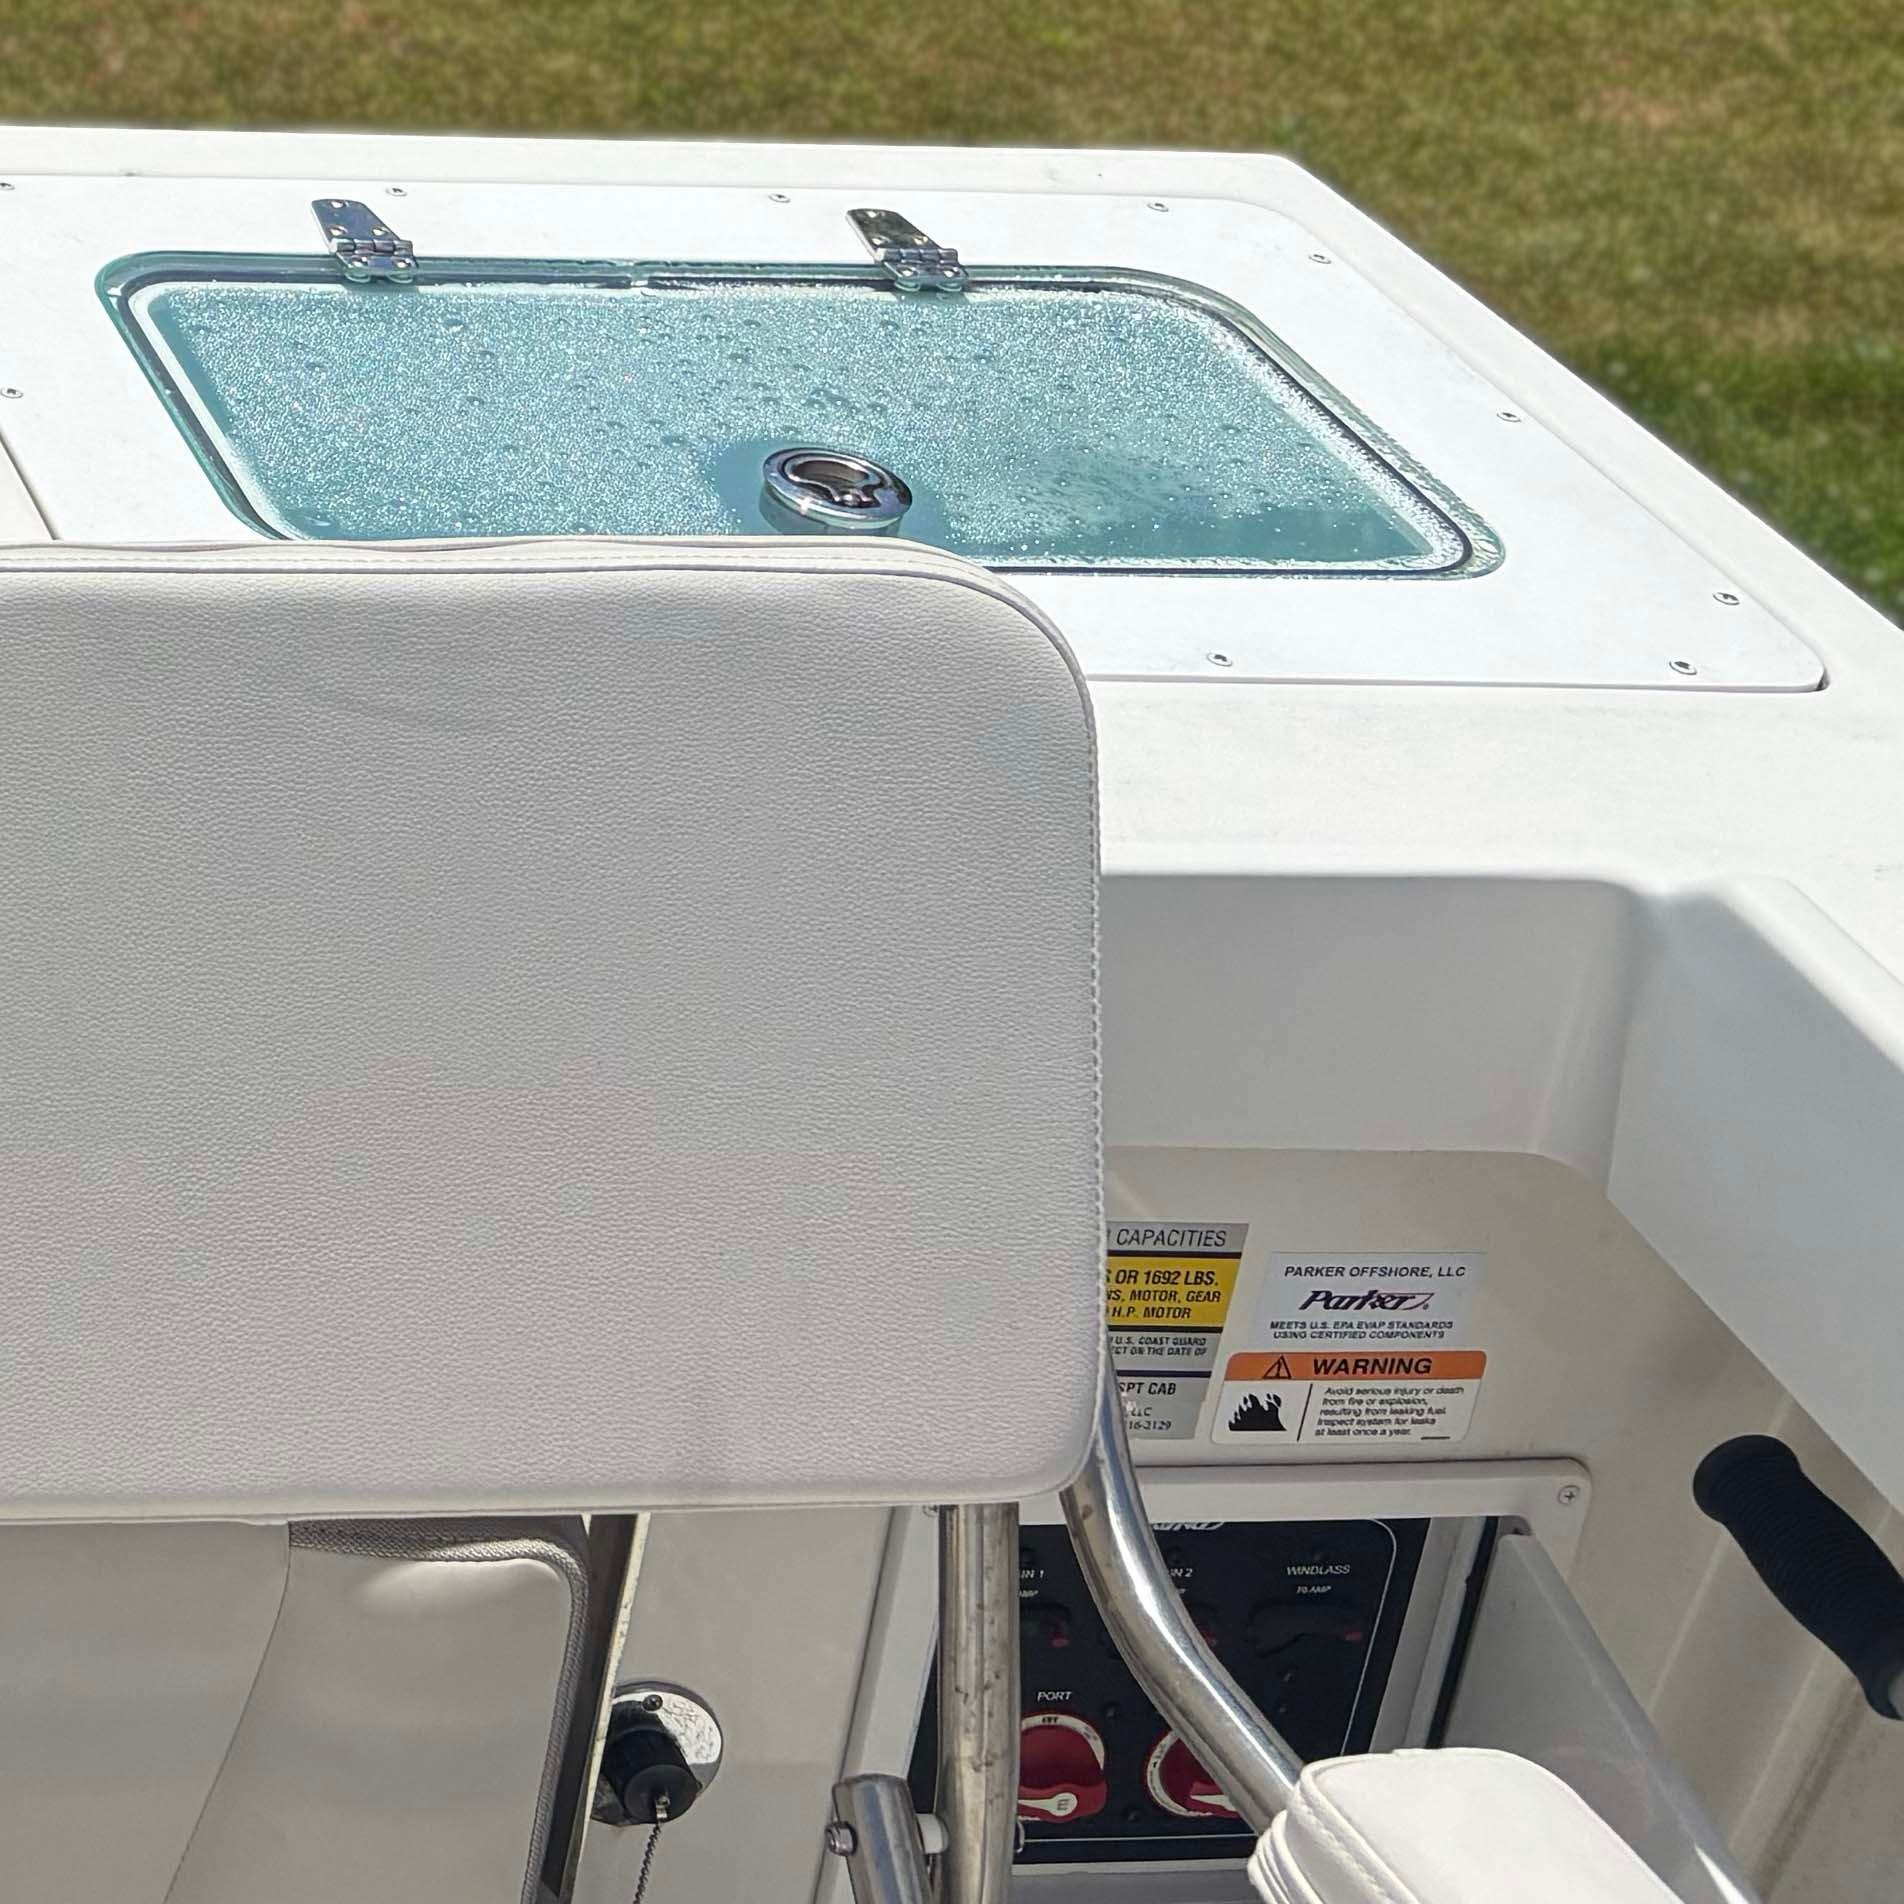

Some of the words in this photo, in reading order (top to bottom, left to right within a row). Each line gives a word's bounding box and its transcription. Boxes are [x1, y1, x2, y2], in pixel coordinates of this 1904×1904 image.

[1116, 1228, 1227, 1247] CAPACITIES
[1115, 1269, 1139, 1285] OR
[1144, 1270, 1181, 1285] 1692
[1184, 1270, 1219, 1286] LBS.
[1284, 1266, 1345, 1277] PARKER
[1349, 1266, 1433, 1278] OFFSHORE,
[1437, 1266, 1466, 1277] LLC
[1186, 1290, 1222, 1303] GEAR
[1298, 1289, 1420, 1311] Parker
[1111, 1306, 1138, 1318] H.P.
[1143, 1306, 1192, 1319] MOTOR
[1270, 1321, 1307, 1329] MEETS
[1310, 1321, 1329, 1329] U.S.
[1333, 1321, 1354, 1329] EPA
[1356, 1320, 1386, 1329] EVAP
[1387, 1320, 1453, 1329] STANDARDS
[1273, 1330, 1307, 1339] USING
[1310, 1330, 1367, 1339] CERTIFIED
[1369, 1330, 1445, 1339] COMPONENTS
[1138, 1336, 1170, 1345] COAST
[1172, 1337, 1207, 1346] GUARD
[1312, 1358, 1433, 1375] WARNING
[1148, 1381, 1177, 1395] CAB
[1324, 1387, 1353, 1395] Avoid
[1355, 1387, 1392, 1395] serious
[1394, 1387, 1422, 1396] injury
[1423, 1387, 1435, 1395] or
[1436, 1386, 1465, 1395] death
[1322, 1397, 1345, 1406] from
[1348, 1397, 1364, 1406] fire
[1366, 1398, 1376, 1406] or
[1319, 1407, 1362, 1417] resulting
[1365, 1407, 1388, 1415] from
[1389, 1407, 1425, 1417] leaking
[1317, 1417, 1355, 1427] Inspect
[1356, 1418, 1392, 1427] system
[1394, 1417, 1409, 1425] for
[1411, 1417, 1436, 1426] leaks
[1315, 1428, 1325, 1436] at
[1327, 1427, 1351, 1436] least
[1352, 1428, 1378, 1436] once
[1287, 1563, 1352, 1576] WINDLASS
[1037, 1690, 1073, 1703] PORT
